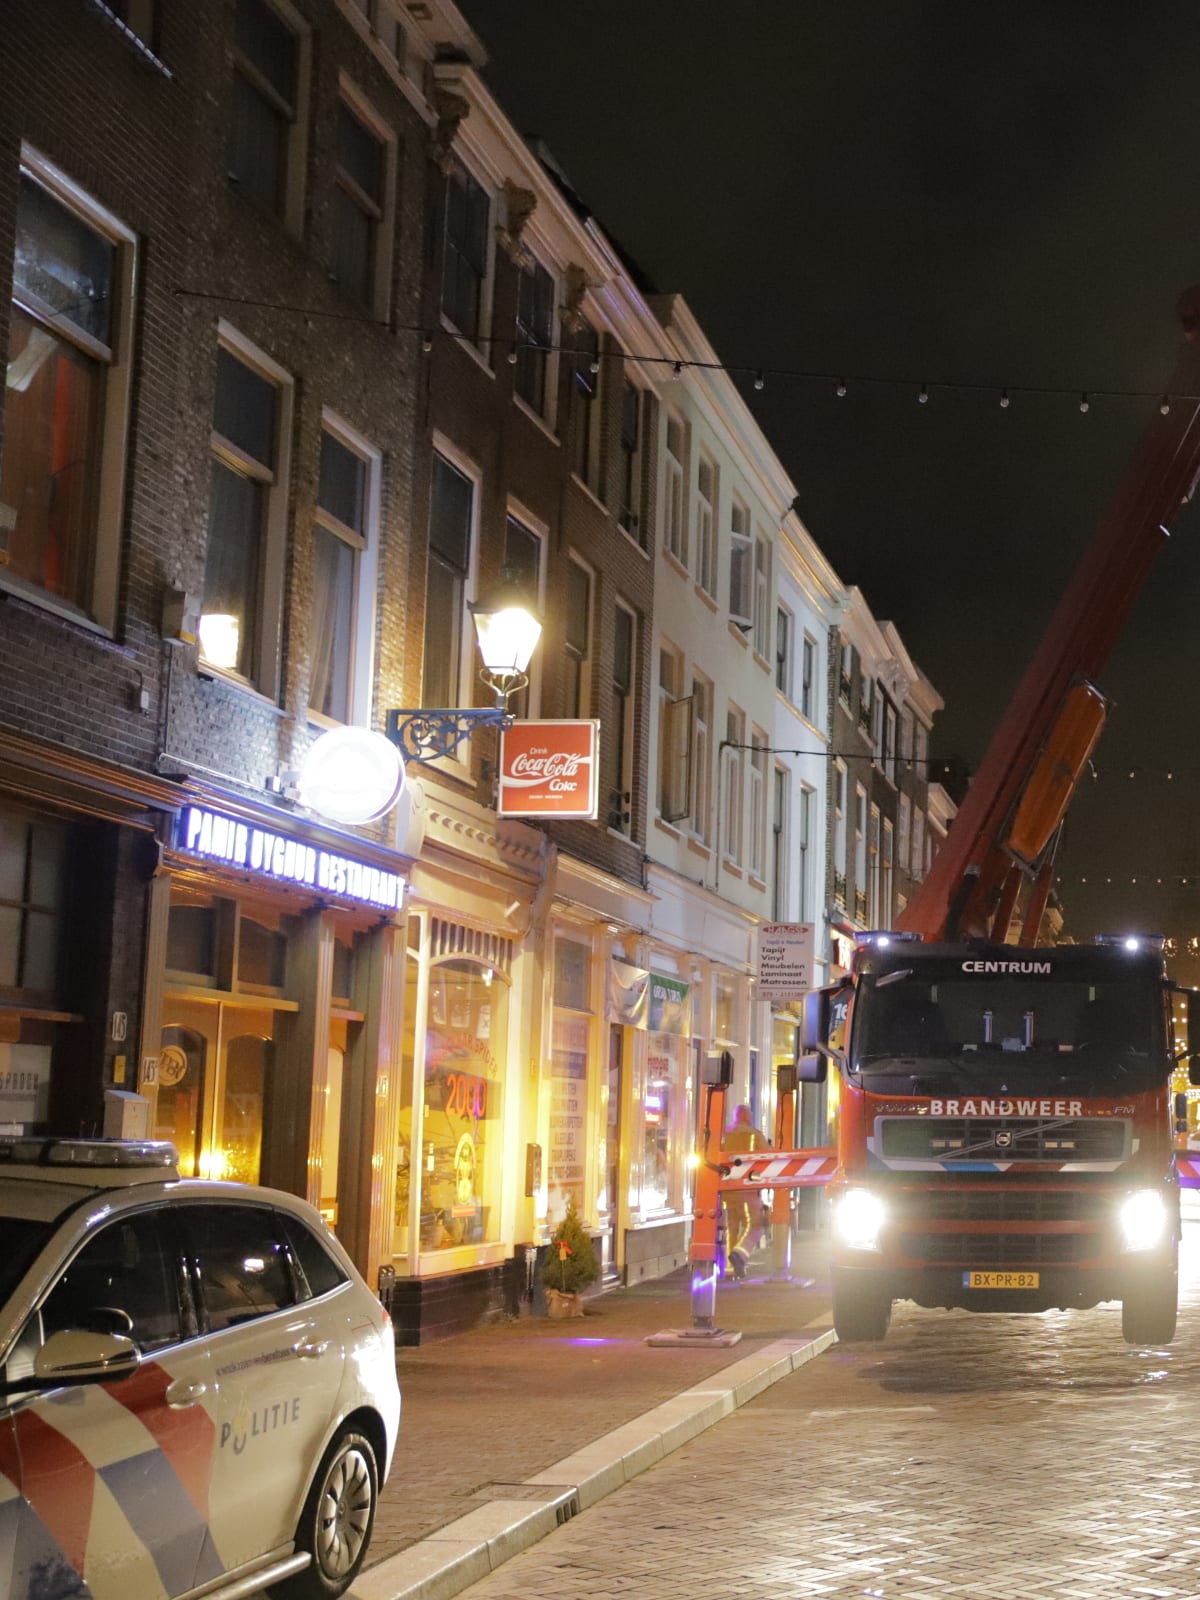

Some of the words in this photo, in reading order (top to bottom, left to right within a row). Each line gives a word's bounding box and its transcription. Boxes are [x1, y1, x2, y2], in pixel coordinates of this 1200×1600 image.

[510, 752, 582, 777] Coca-Cola
[548, 779, 578, 791] Coke
[187, 807, 248, 864] PAMIR
[318, 852, 406, 909] RESTAURANT
[761, 947, 786, 955] Tapijt
[961, 961, 1051, 974] CENTRUM
[446, 1074, 487, 1116] 2000
[930, 1099, 1083, 1117] BRANDWEER
[1113, 1104, 1135, 1115] FM
[973, 1273, 1035, 1287] BX-PR-82
[220, 1397, 300, 1456] POLITIE
